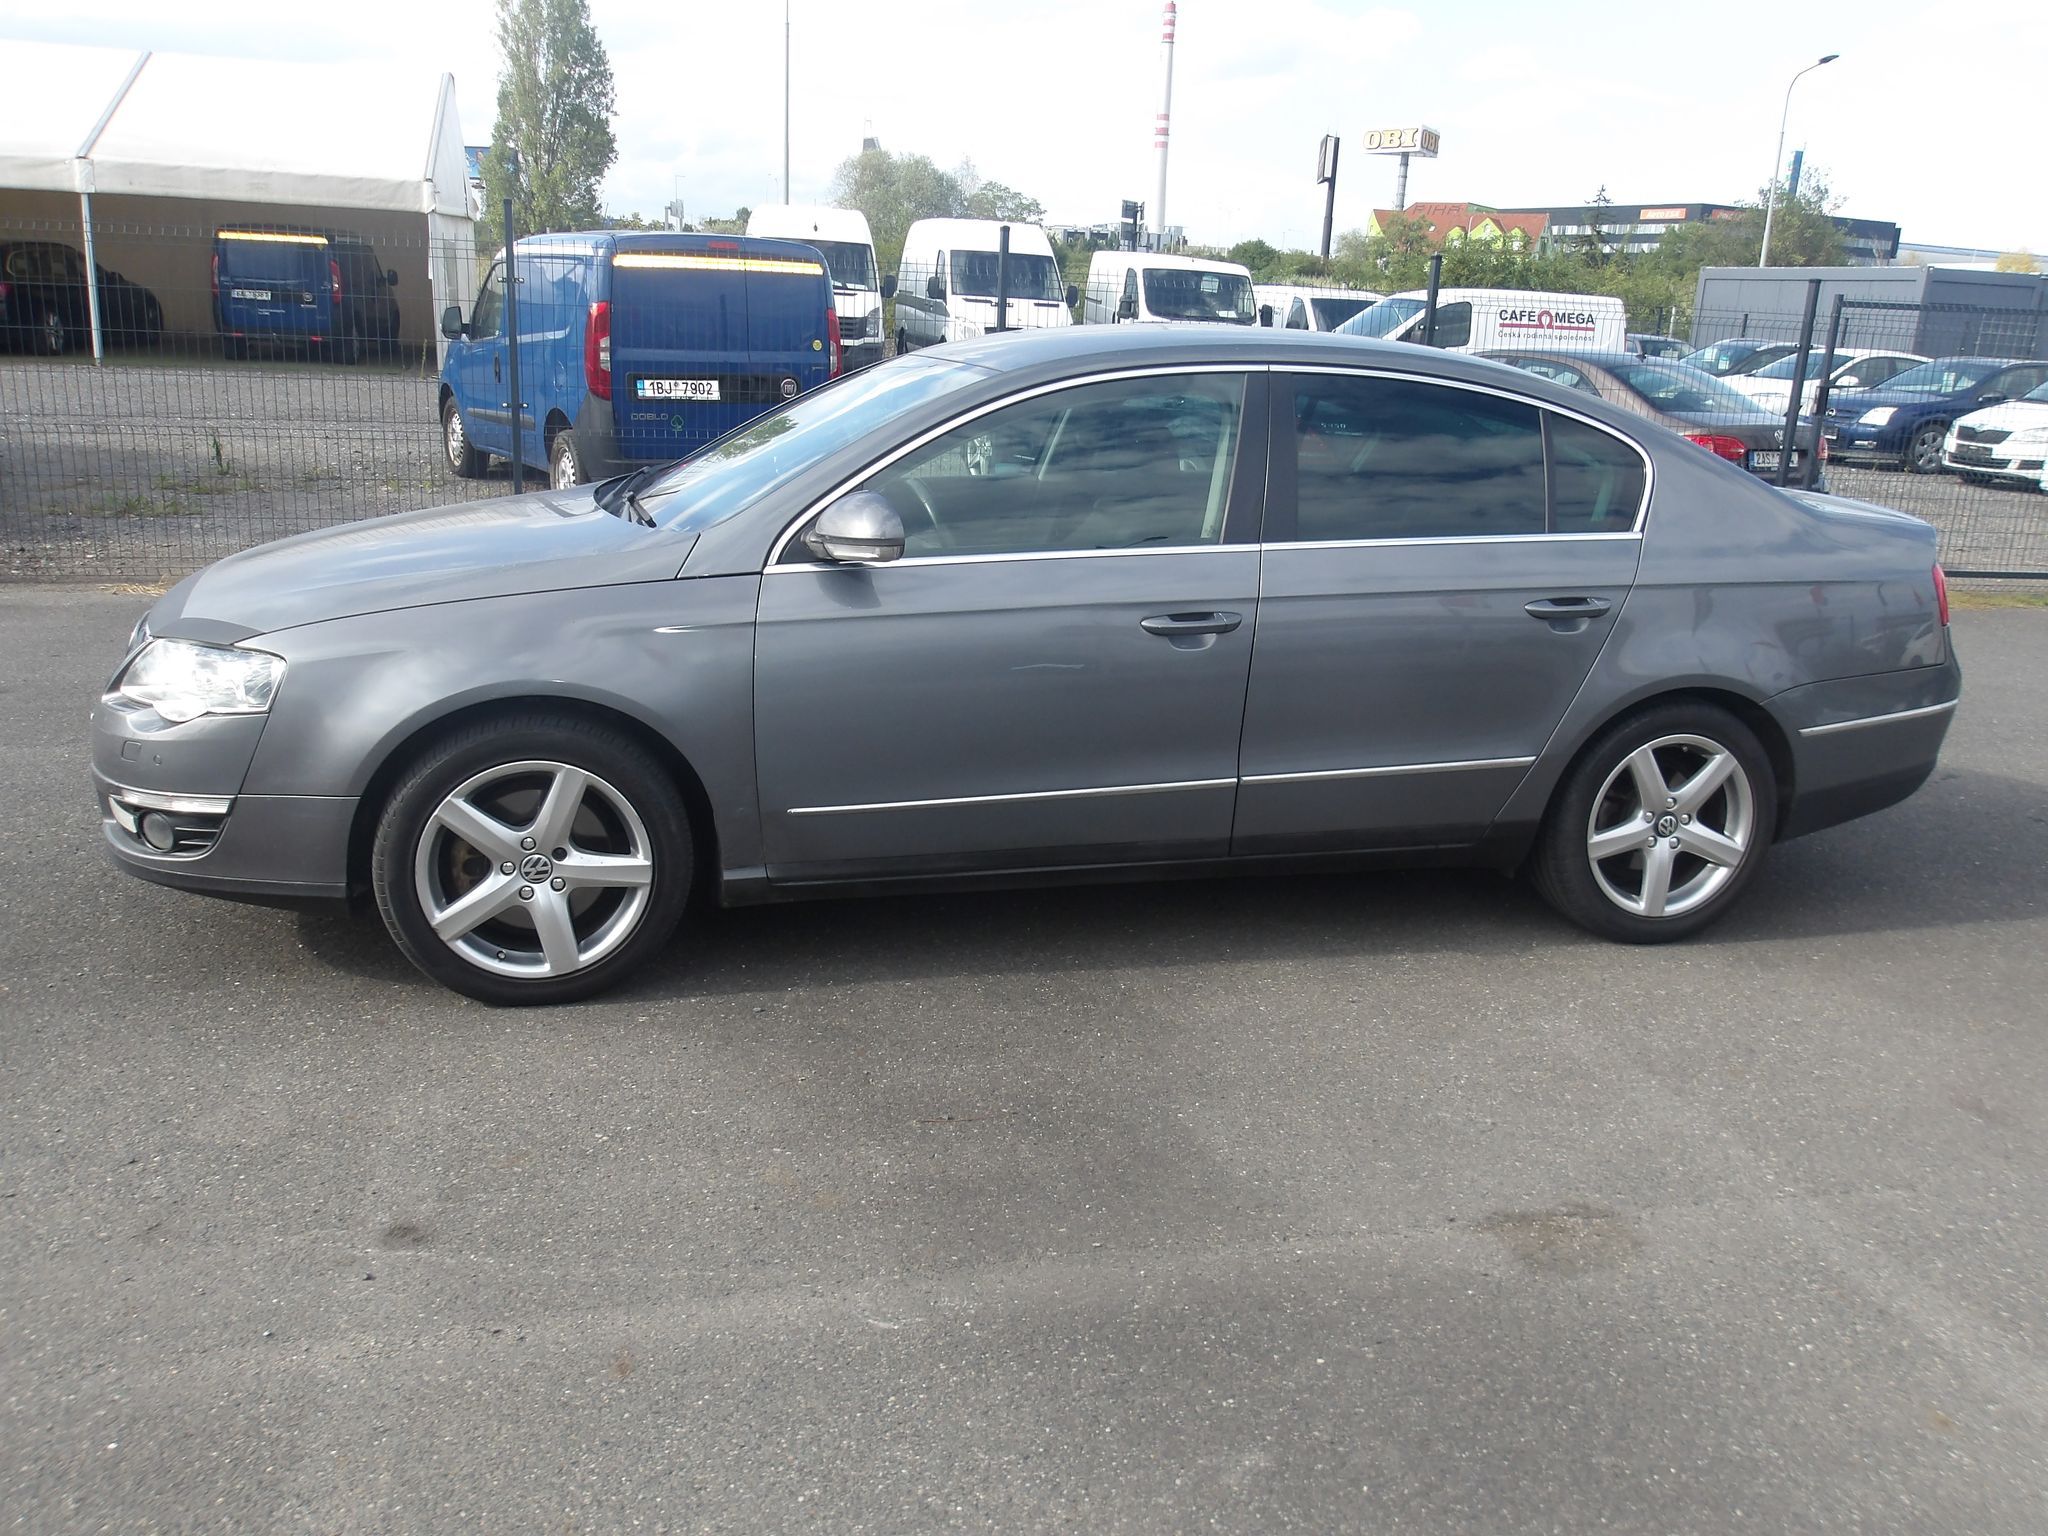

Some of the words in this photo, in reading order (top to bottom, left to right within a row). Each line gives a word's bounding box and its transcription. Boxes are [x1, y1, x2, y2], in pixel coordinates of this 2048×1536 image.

[1363, 128, 1419, 150] OBI
[1421, 129, 1440, 153] OBI
[1499, 309, 1536, 322] CAFE
[649, 381, 673, 395] 1BJ
[681, 382, 714, 396] 7902
[631, 413, 669, 421] DOBLO
